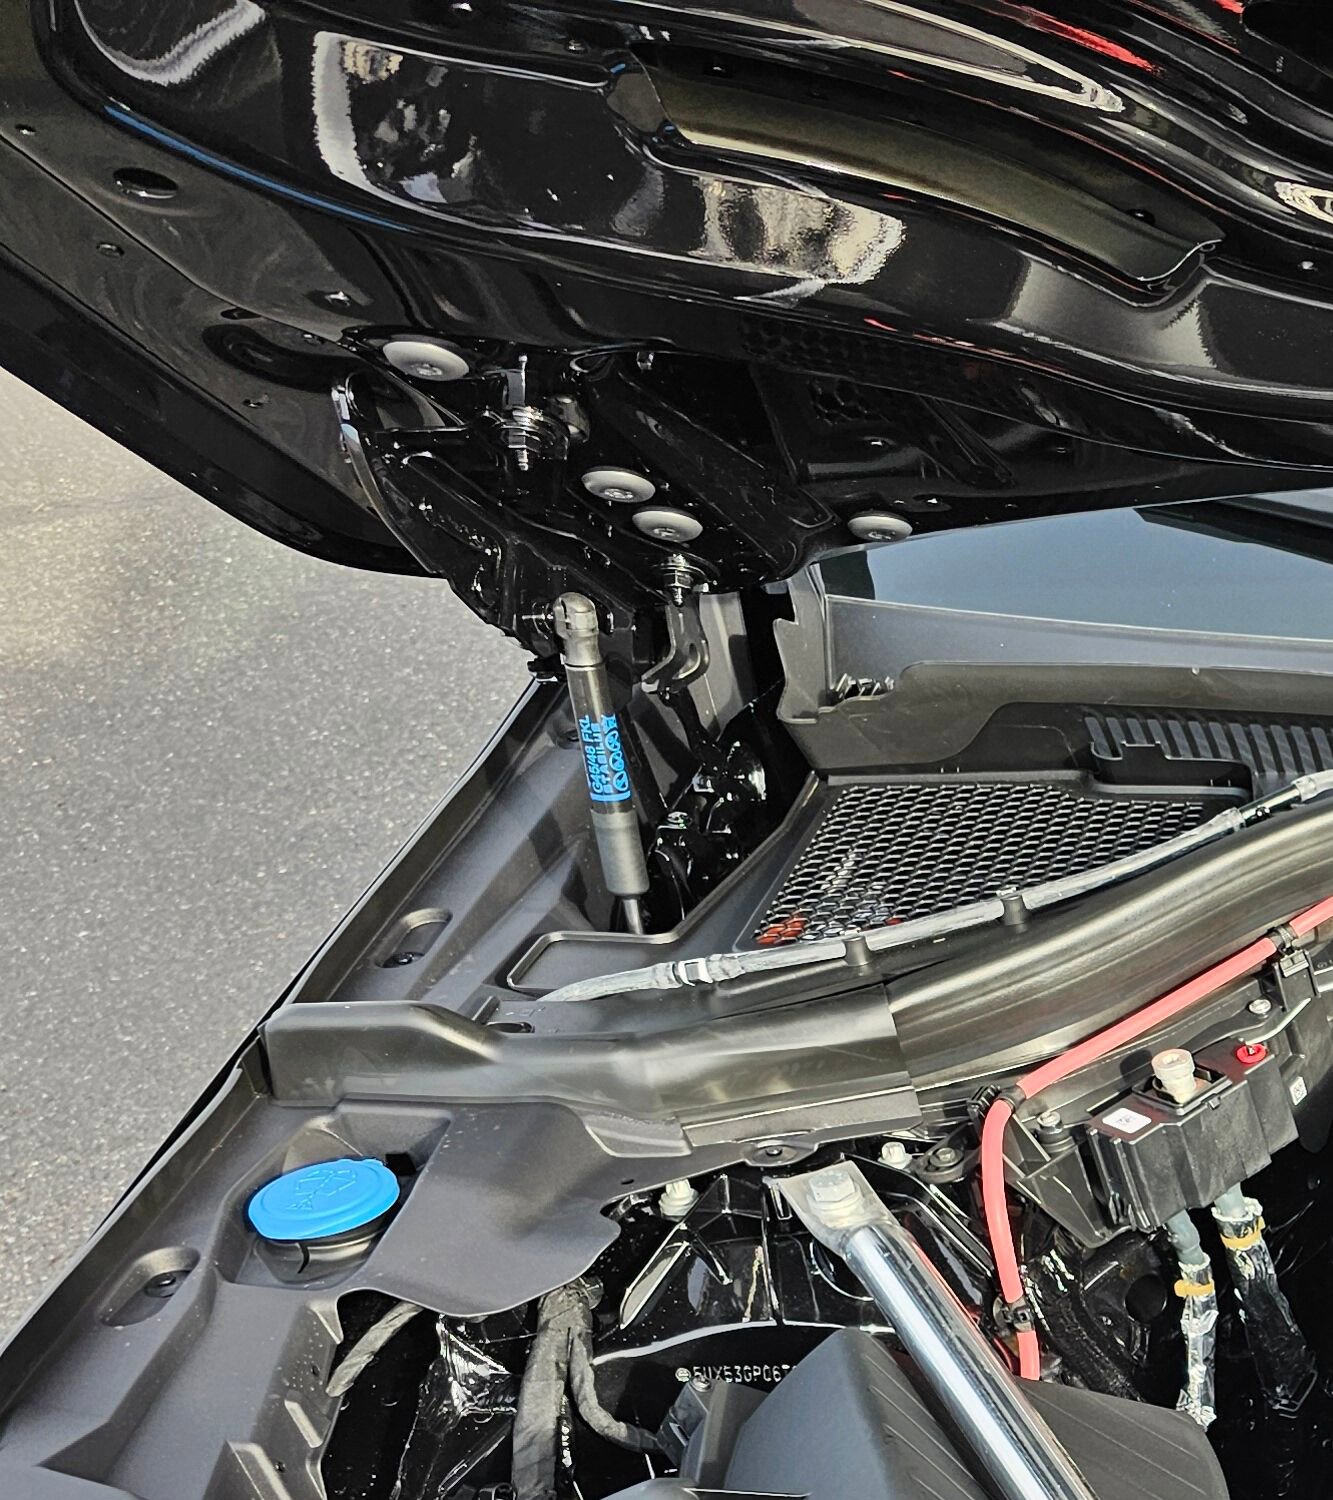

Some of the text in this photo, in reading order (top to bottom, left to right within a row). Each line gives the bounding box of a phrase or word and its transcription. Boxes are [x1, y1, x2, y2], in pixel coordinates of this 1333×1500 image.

[578, 715, 603, 793] G45/48 FKL
[591, 723, 613, 793] STABILUS
